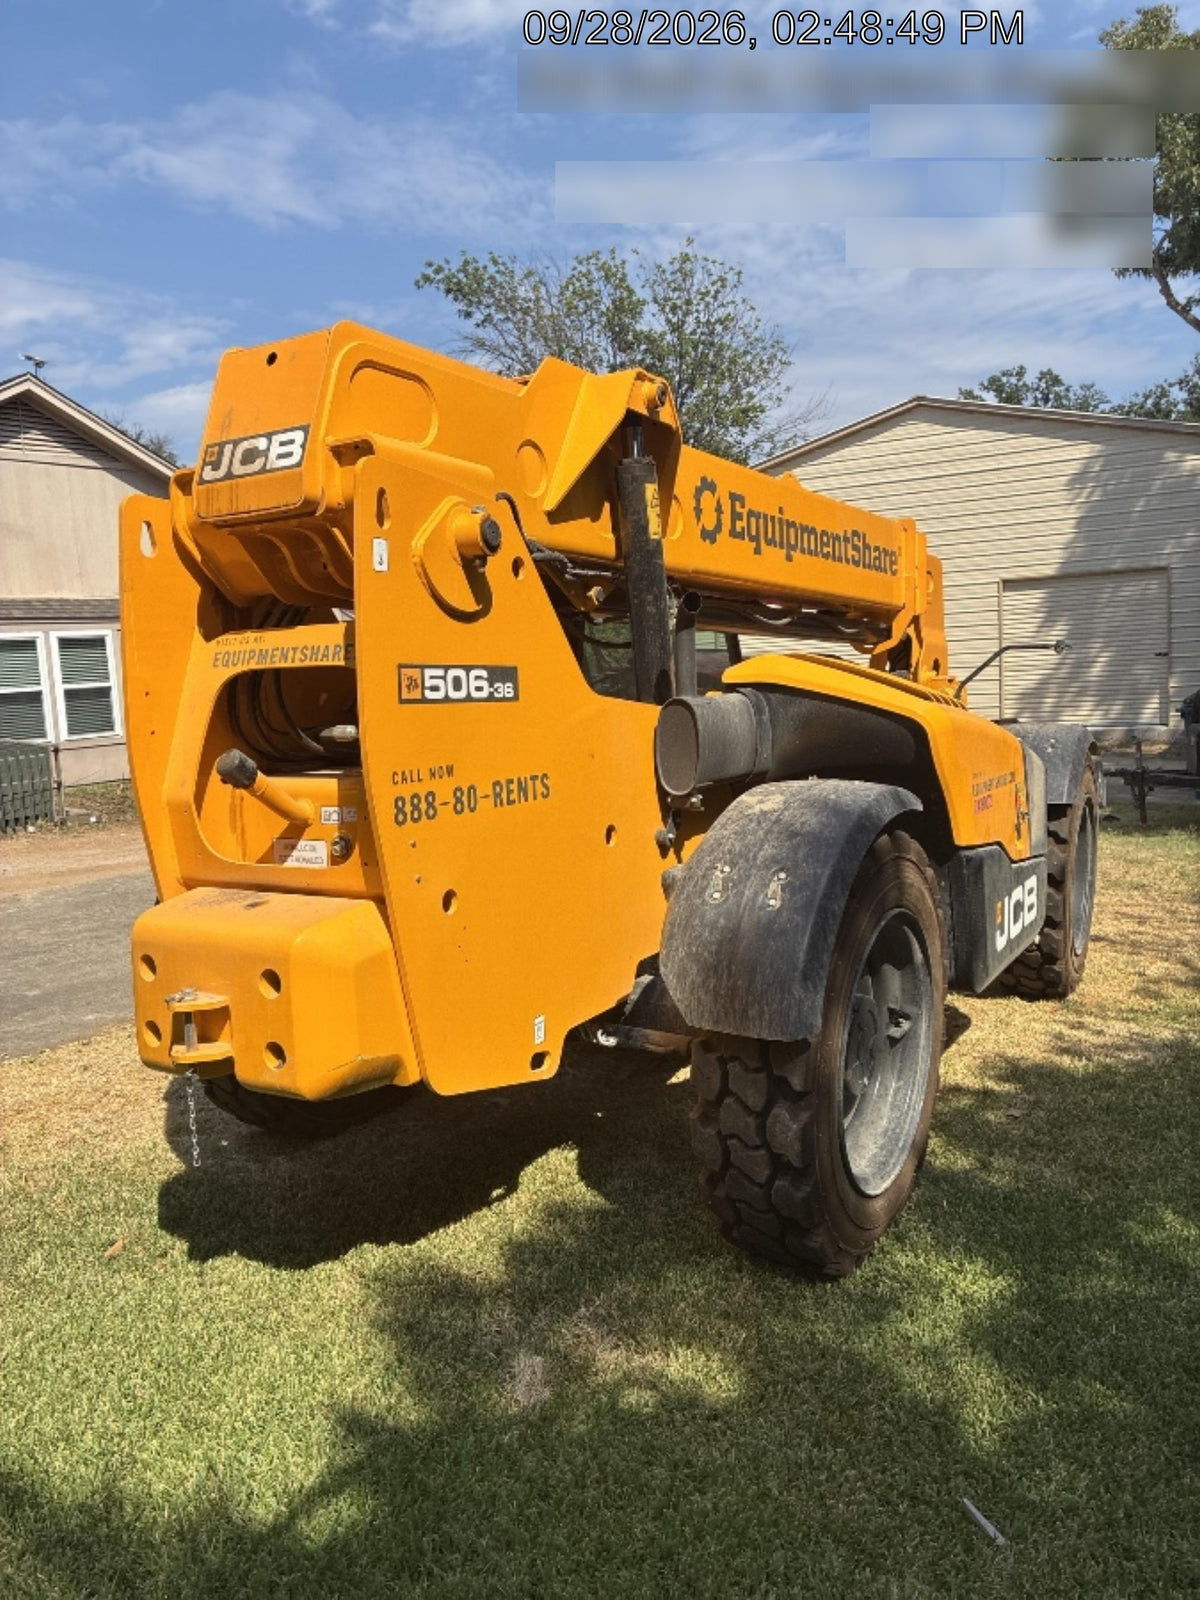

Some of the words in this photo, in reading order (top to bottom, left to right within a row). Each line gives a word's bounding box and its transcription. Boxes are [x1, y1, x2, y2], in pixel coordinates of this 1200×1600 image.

[202, 430, 305, 481] JCB
[729, 490, 899, 577] EquipmentShare
[392, 768, 424, 785] CALL
[429, 763, 455, 781] NOW
[394, 772, 551, 827] 888-80-RENTS
[995, 874, 1038, 952] JCB
